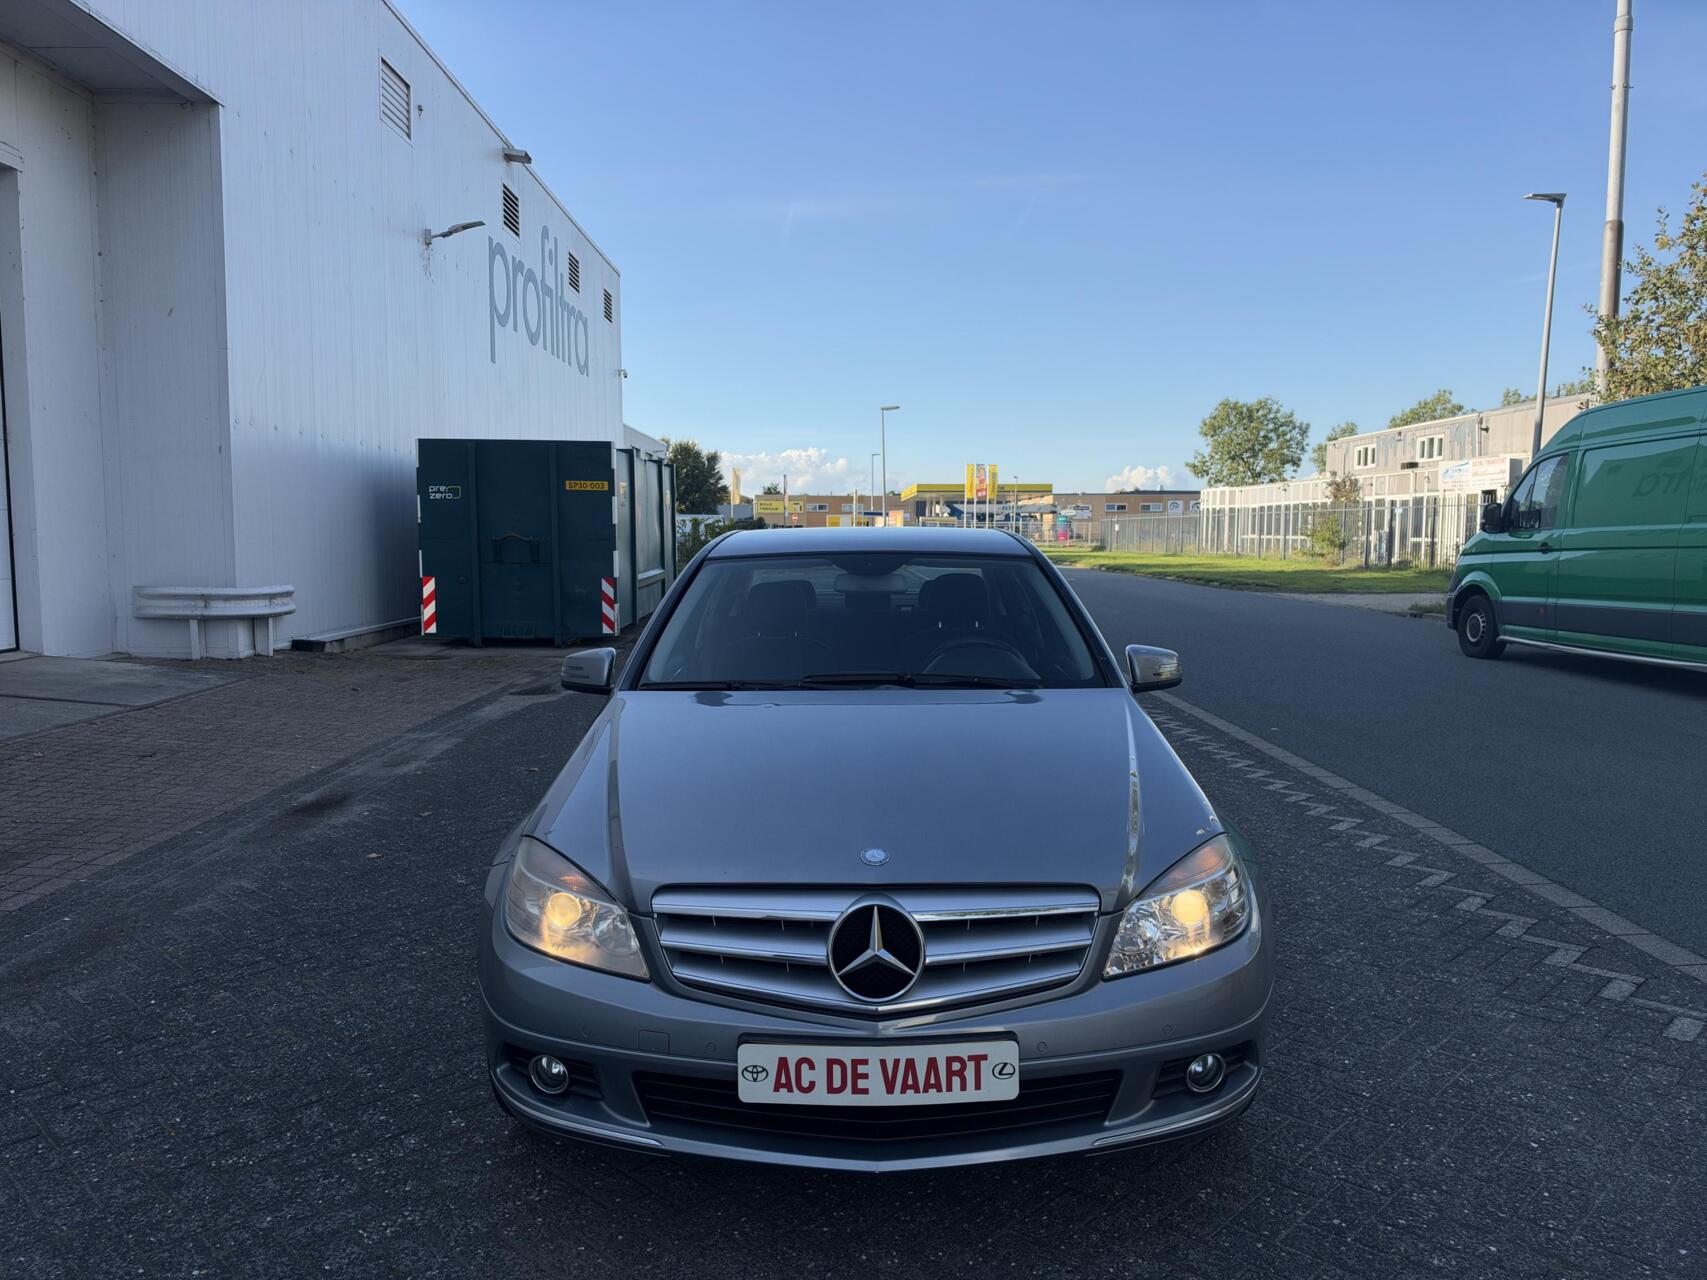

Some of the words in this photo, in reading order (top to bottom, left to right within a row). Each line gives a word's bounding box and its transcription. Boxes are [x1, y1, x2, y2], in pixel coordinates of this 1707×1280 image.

[488, 225, 589, 377] profiltra
[428, 485, 446, 493] pre
[773, 1056, 816, 1094] AC
[826, 1058, 870, 1095] DE
[878, 1053, 988, 1095] VAART
